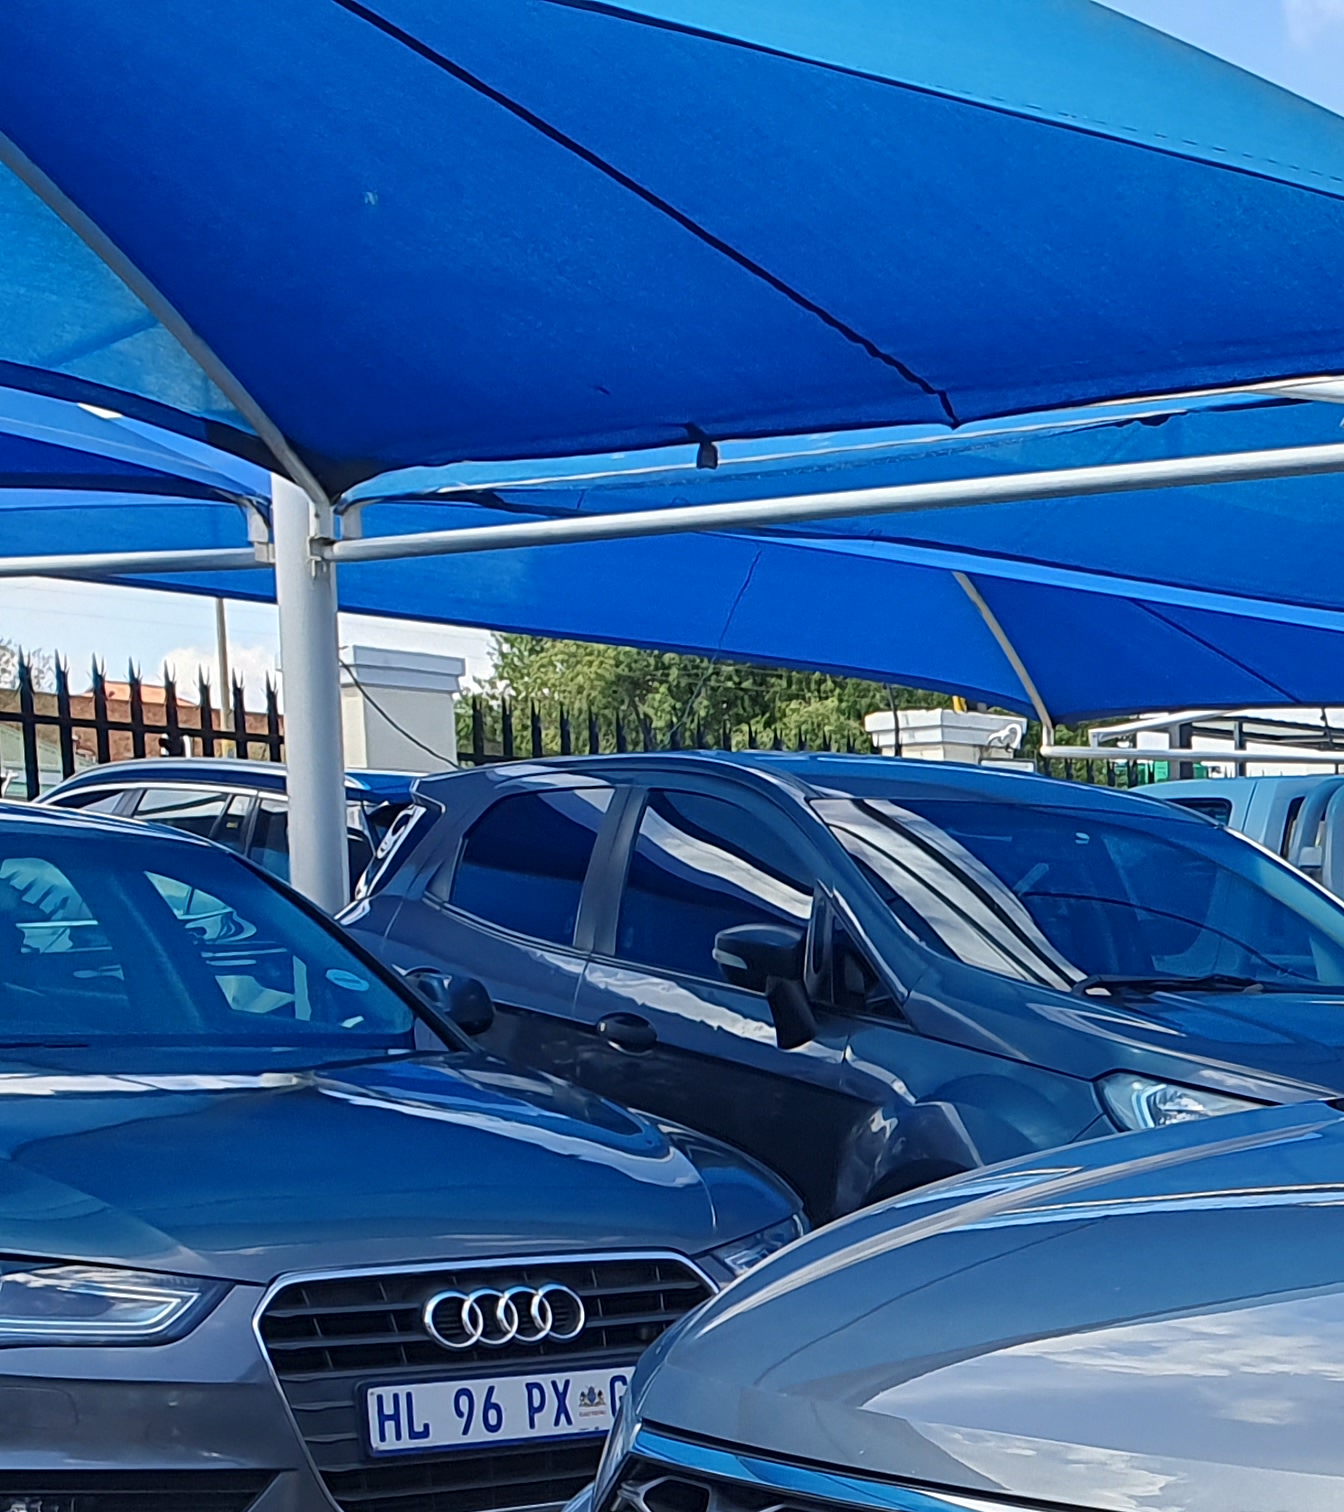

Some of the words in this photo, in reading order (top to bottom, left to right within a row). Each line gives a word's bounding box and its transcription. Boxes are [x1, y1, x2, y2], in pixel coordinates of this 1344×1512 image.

[376, 1391, 431, 1442] HL
[453, 1385, 504, 1436] 96
[525, 1379, 573, 1429] PX
